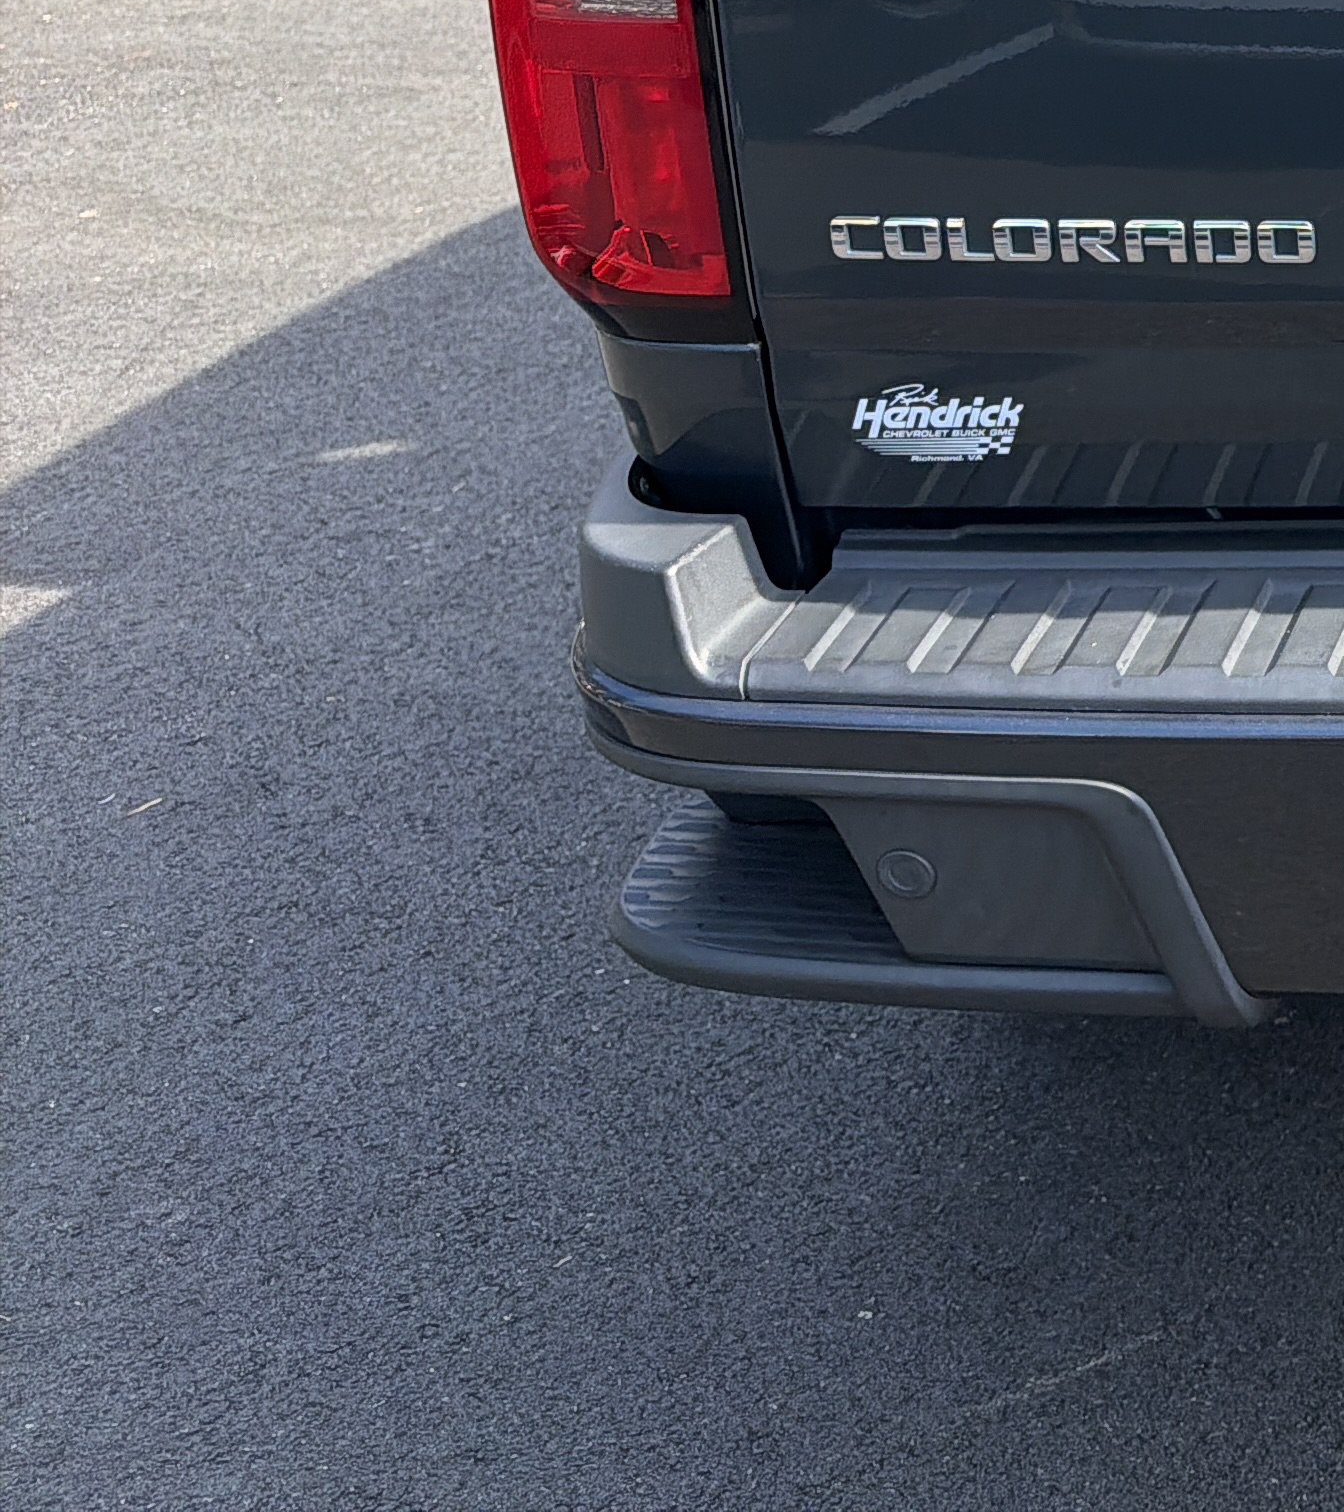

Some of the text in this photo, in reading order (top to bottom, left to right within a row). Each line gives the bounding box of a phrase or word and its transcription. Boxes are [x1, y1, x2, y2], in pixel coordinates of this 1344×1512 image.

[830, 216, 1317, 264] COLORADO
[852, 396, 1025, 439] Hendrick
[882, 428, 1017, 439] CHEVROLET BUICK GMC
[967, 453, 984, 462] VA
